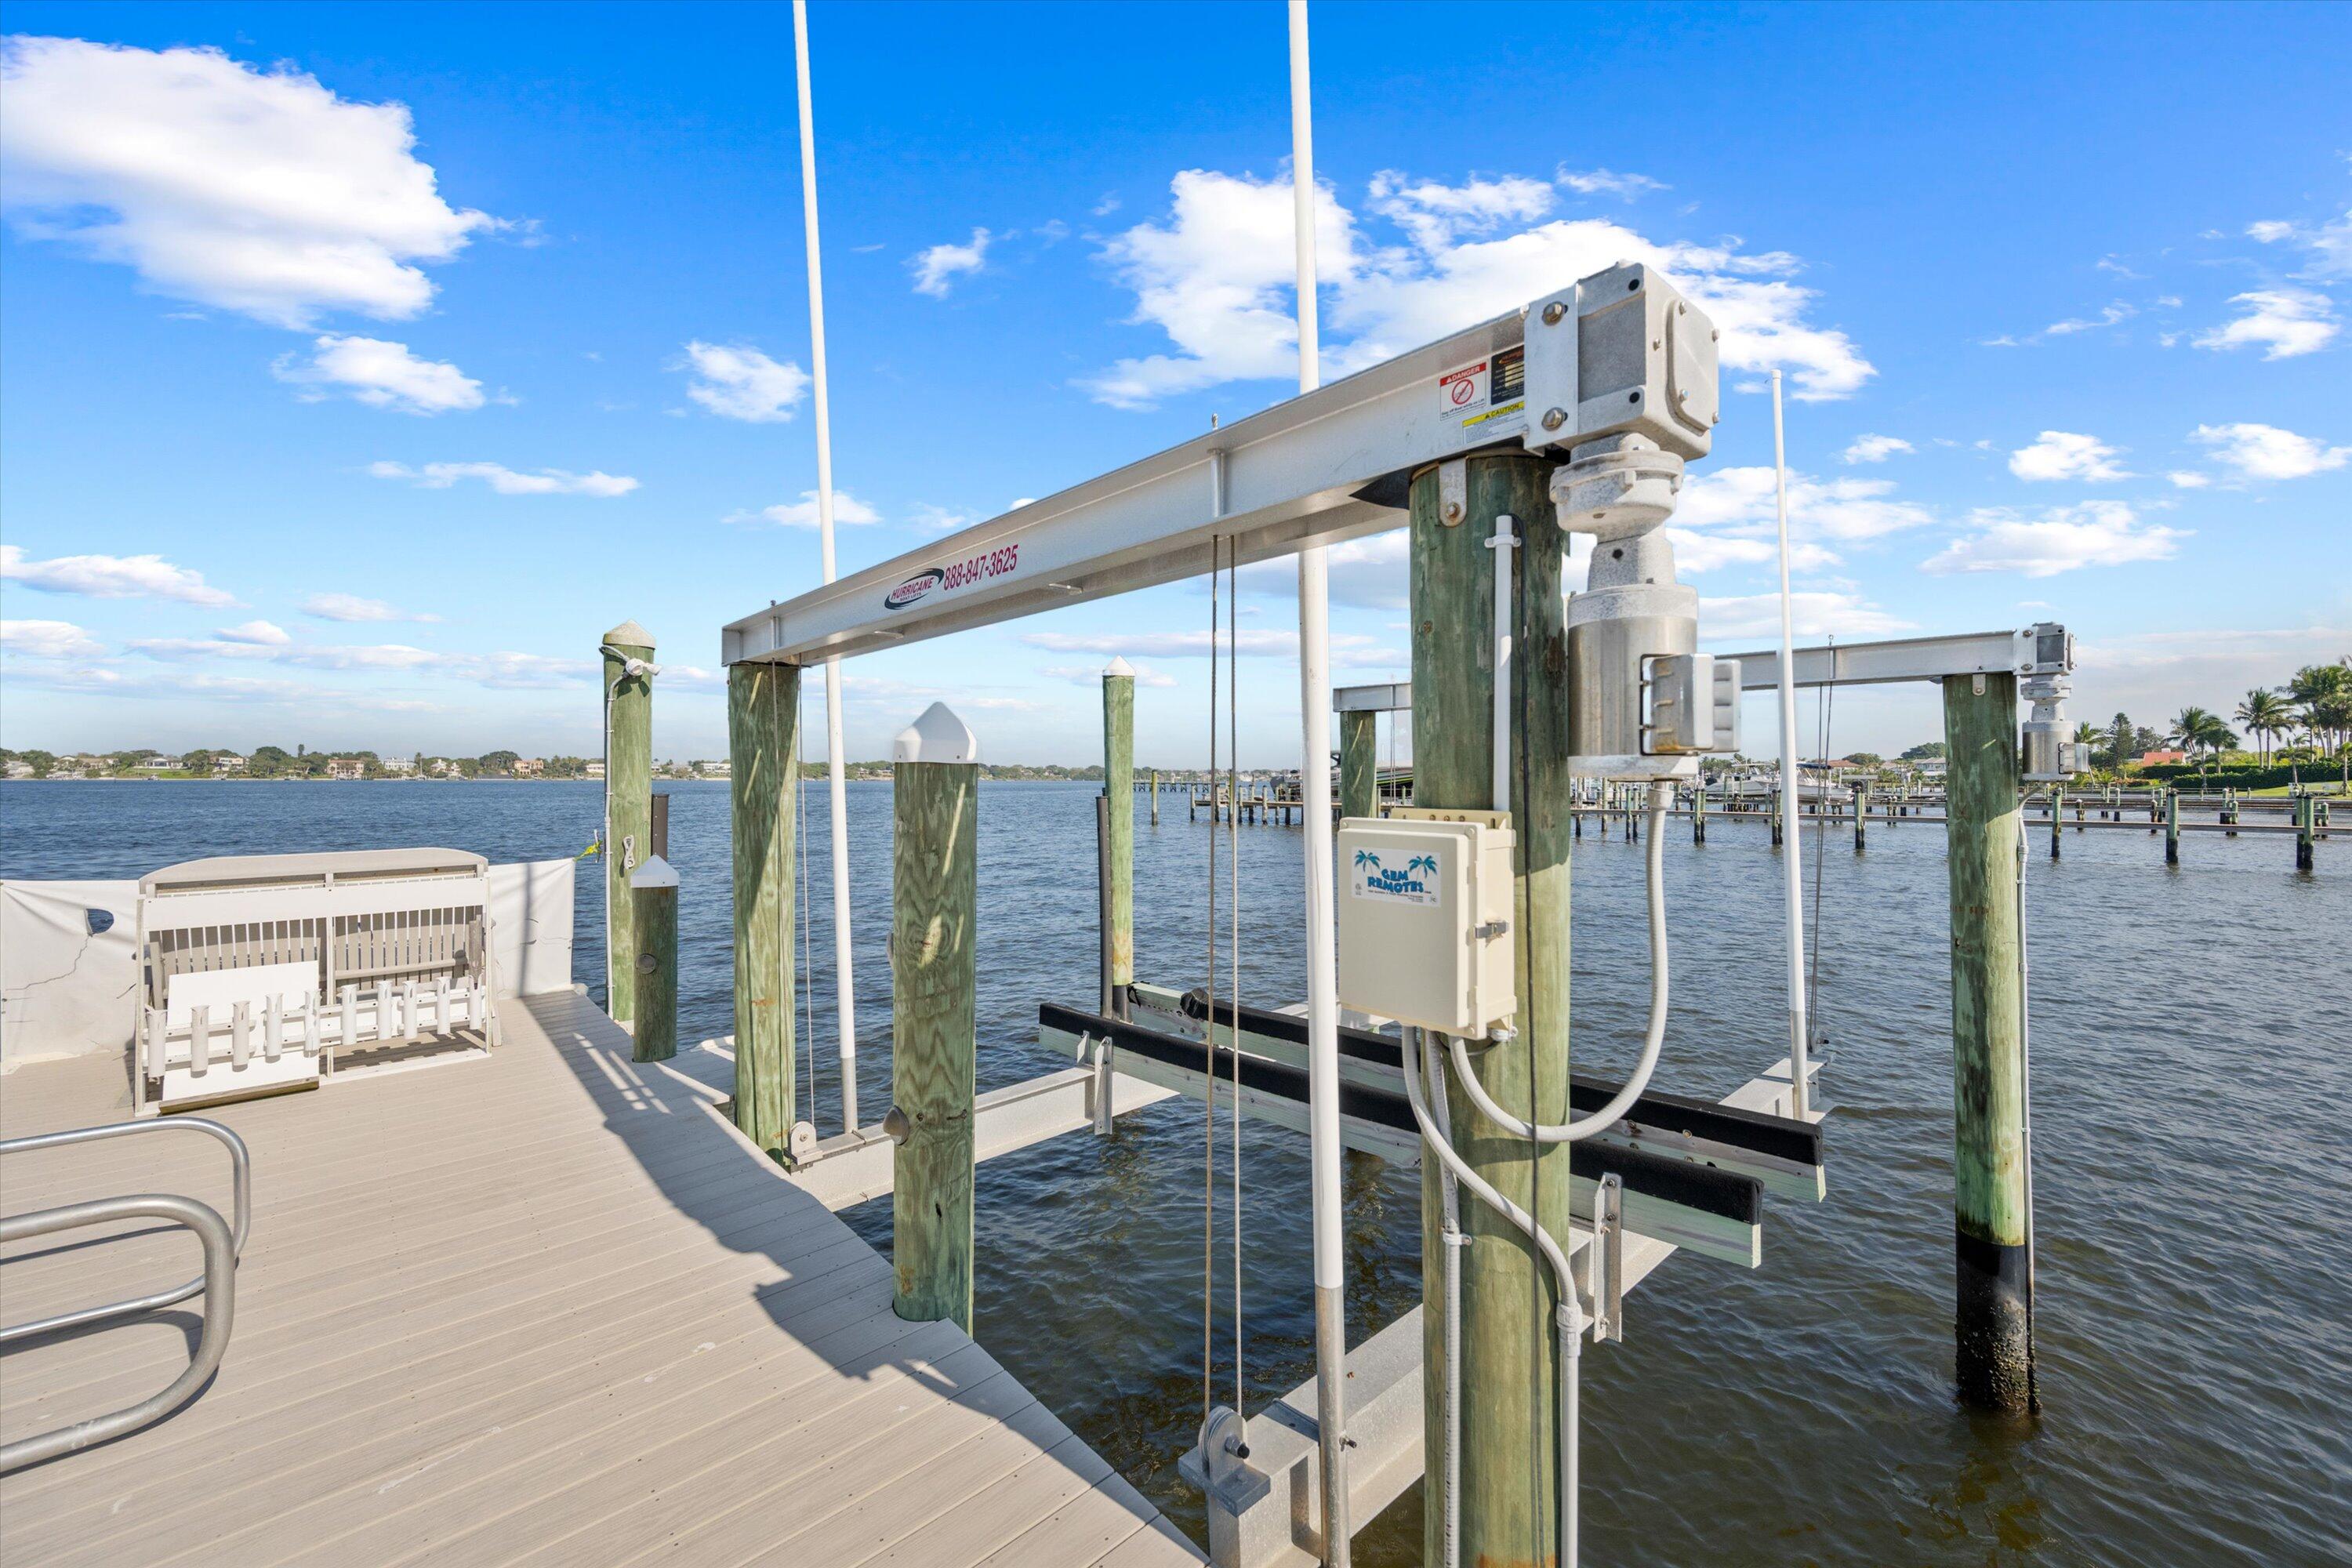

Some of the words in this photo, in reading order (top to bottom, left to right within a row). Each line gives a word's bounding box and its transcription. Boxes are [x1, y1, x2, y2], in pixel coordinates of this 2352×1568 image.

[1453, 365, 1481, 383] DANGER
[1490, 403, 1519, 418] CAUTION
[943, 544, 1018, 591] 888-847-3625
[891, 577, 935, 601] HURRICANE
[1381, 868, 1409, 882] GEM
[1367, 876, 1424, 894] REMOTES
